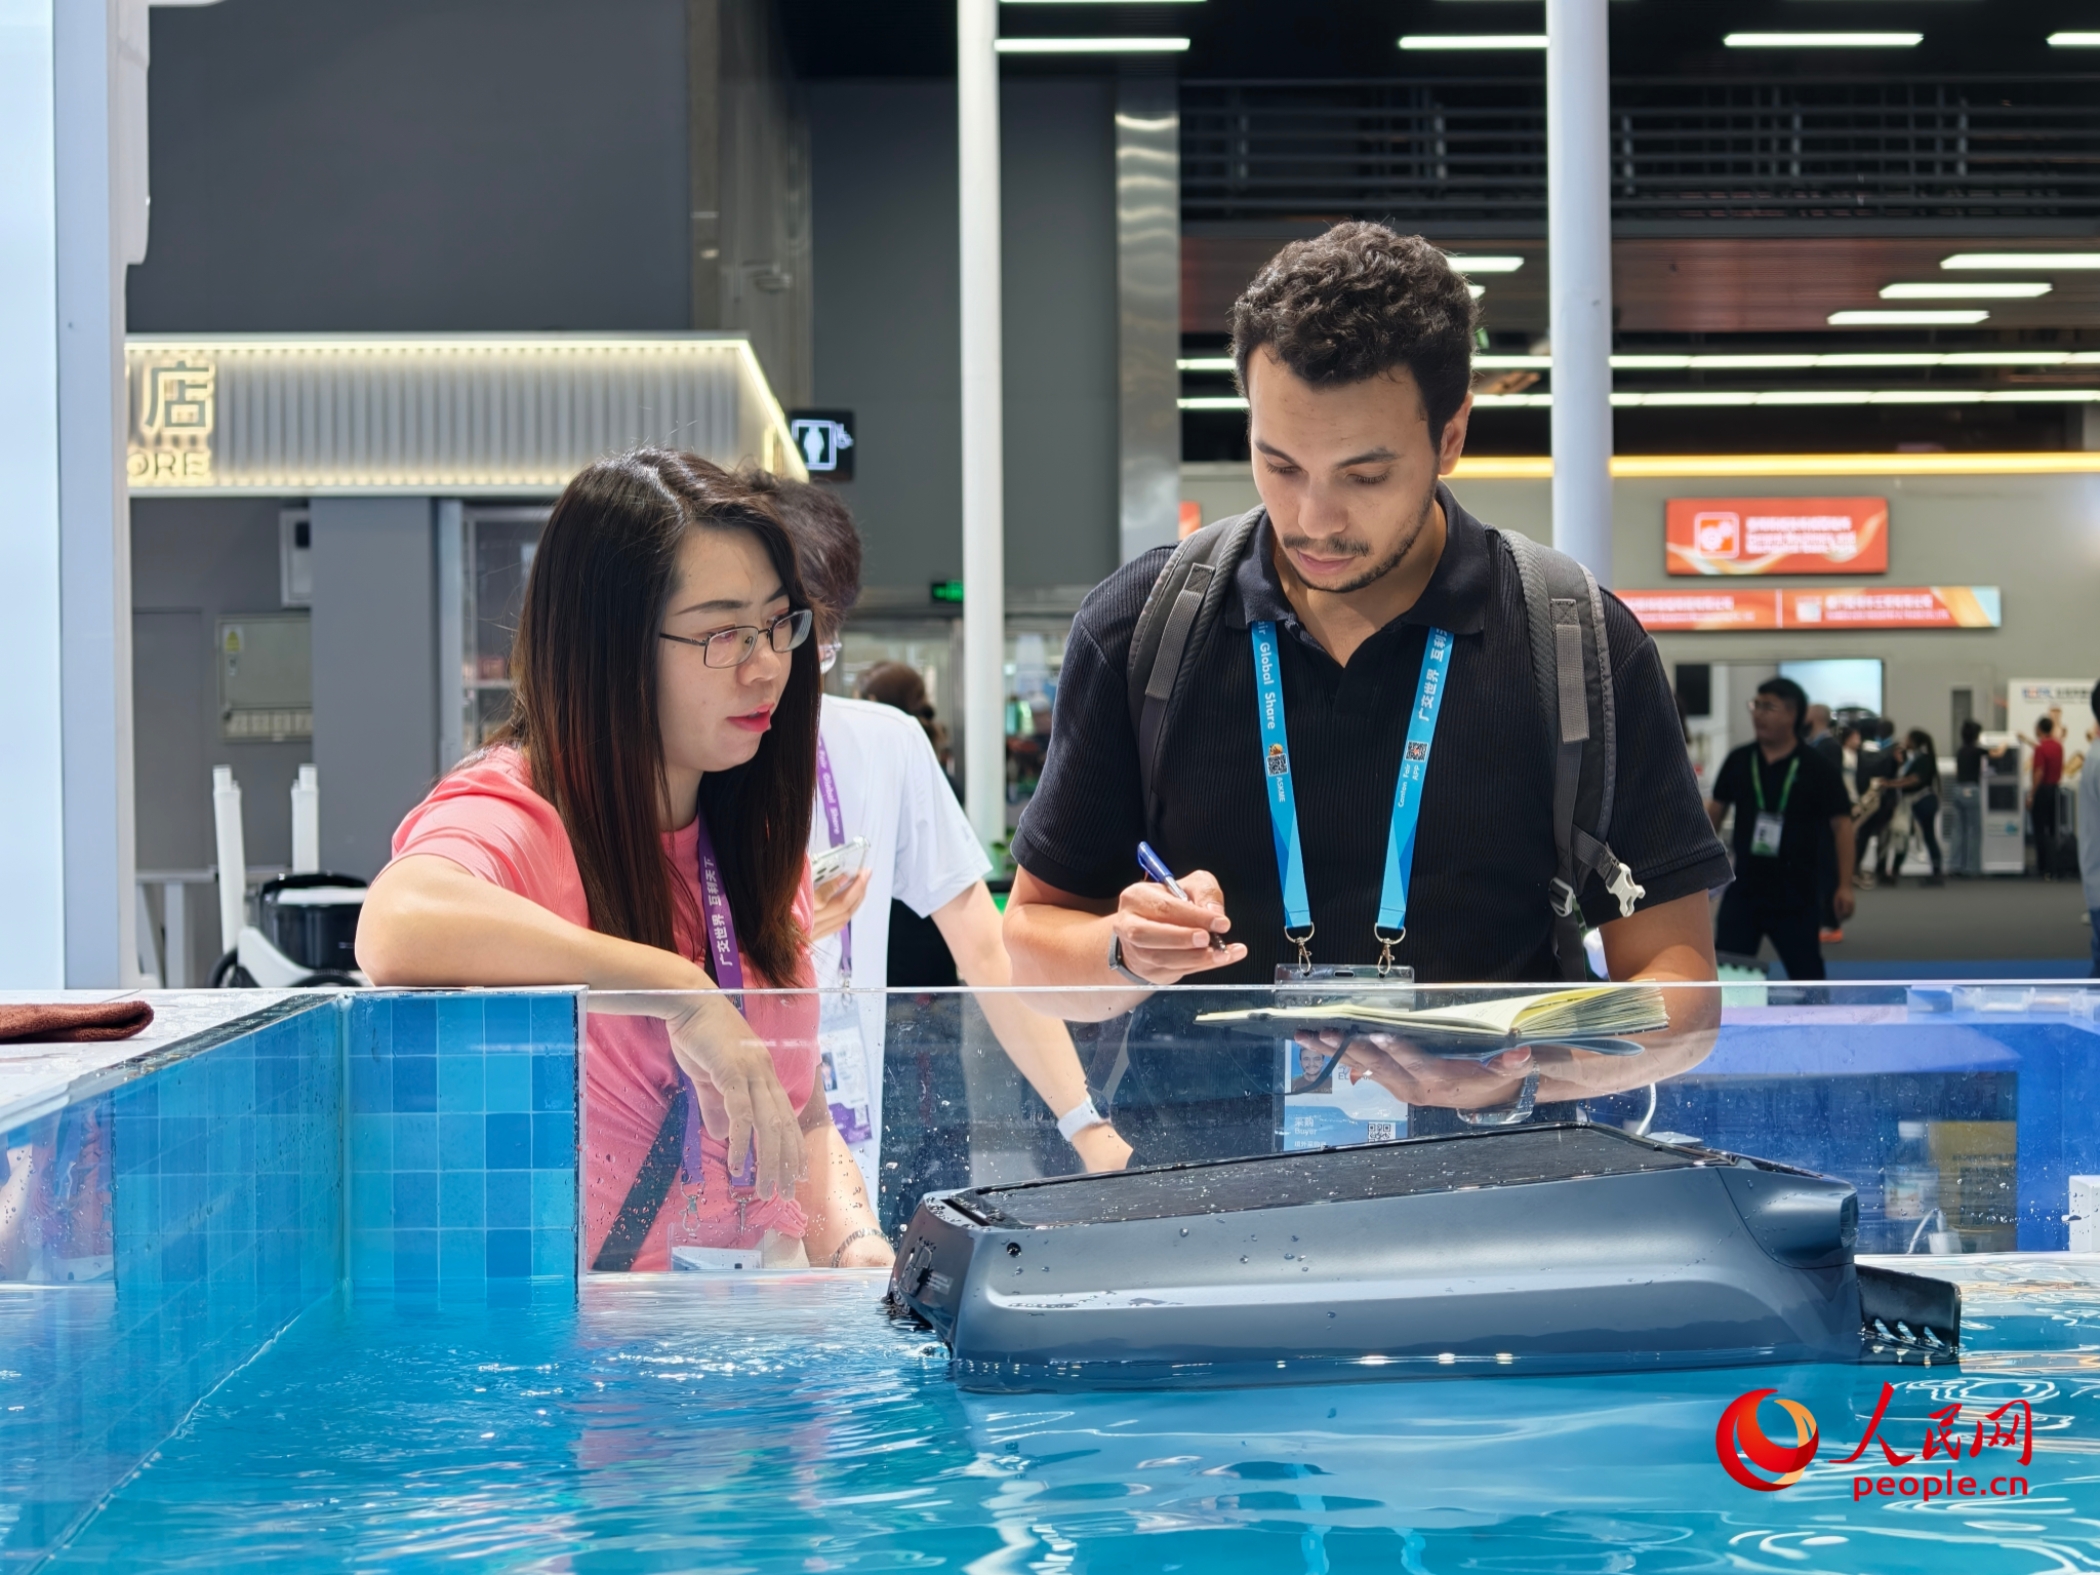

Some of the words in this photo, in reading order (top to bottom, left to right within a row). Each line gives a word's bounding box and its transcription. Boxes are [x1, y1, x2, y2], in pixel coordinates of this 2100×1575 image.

[143, 360, 213, 432] 店
[1259, 642, 1275, 685] Global
[1264, 691, 1277, 730] Share
[1418, 668, 1439, 722] 广交世界
[1397, 781, 1408, 808] Canton
[703, 857, 722, 906] 互利天下
[712, 914, 733, 966] 广交世界
[1294, 1127, 1317, 1137] Buyer
